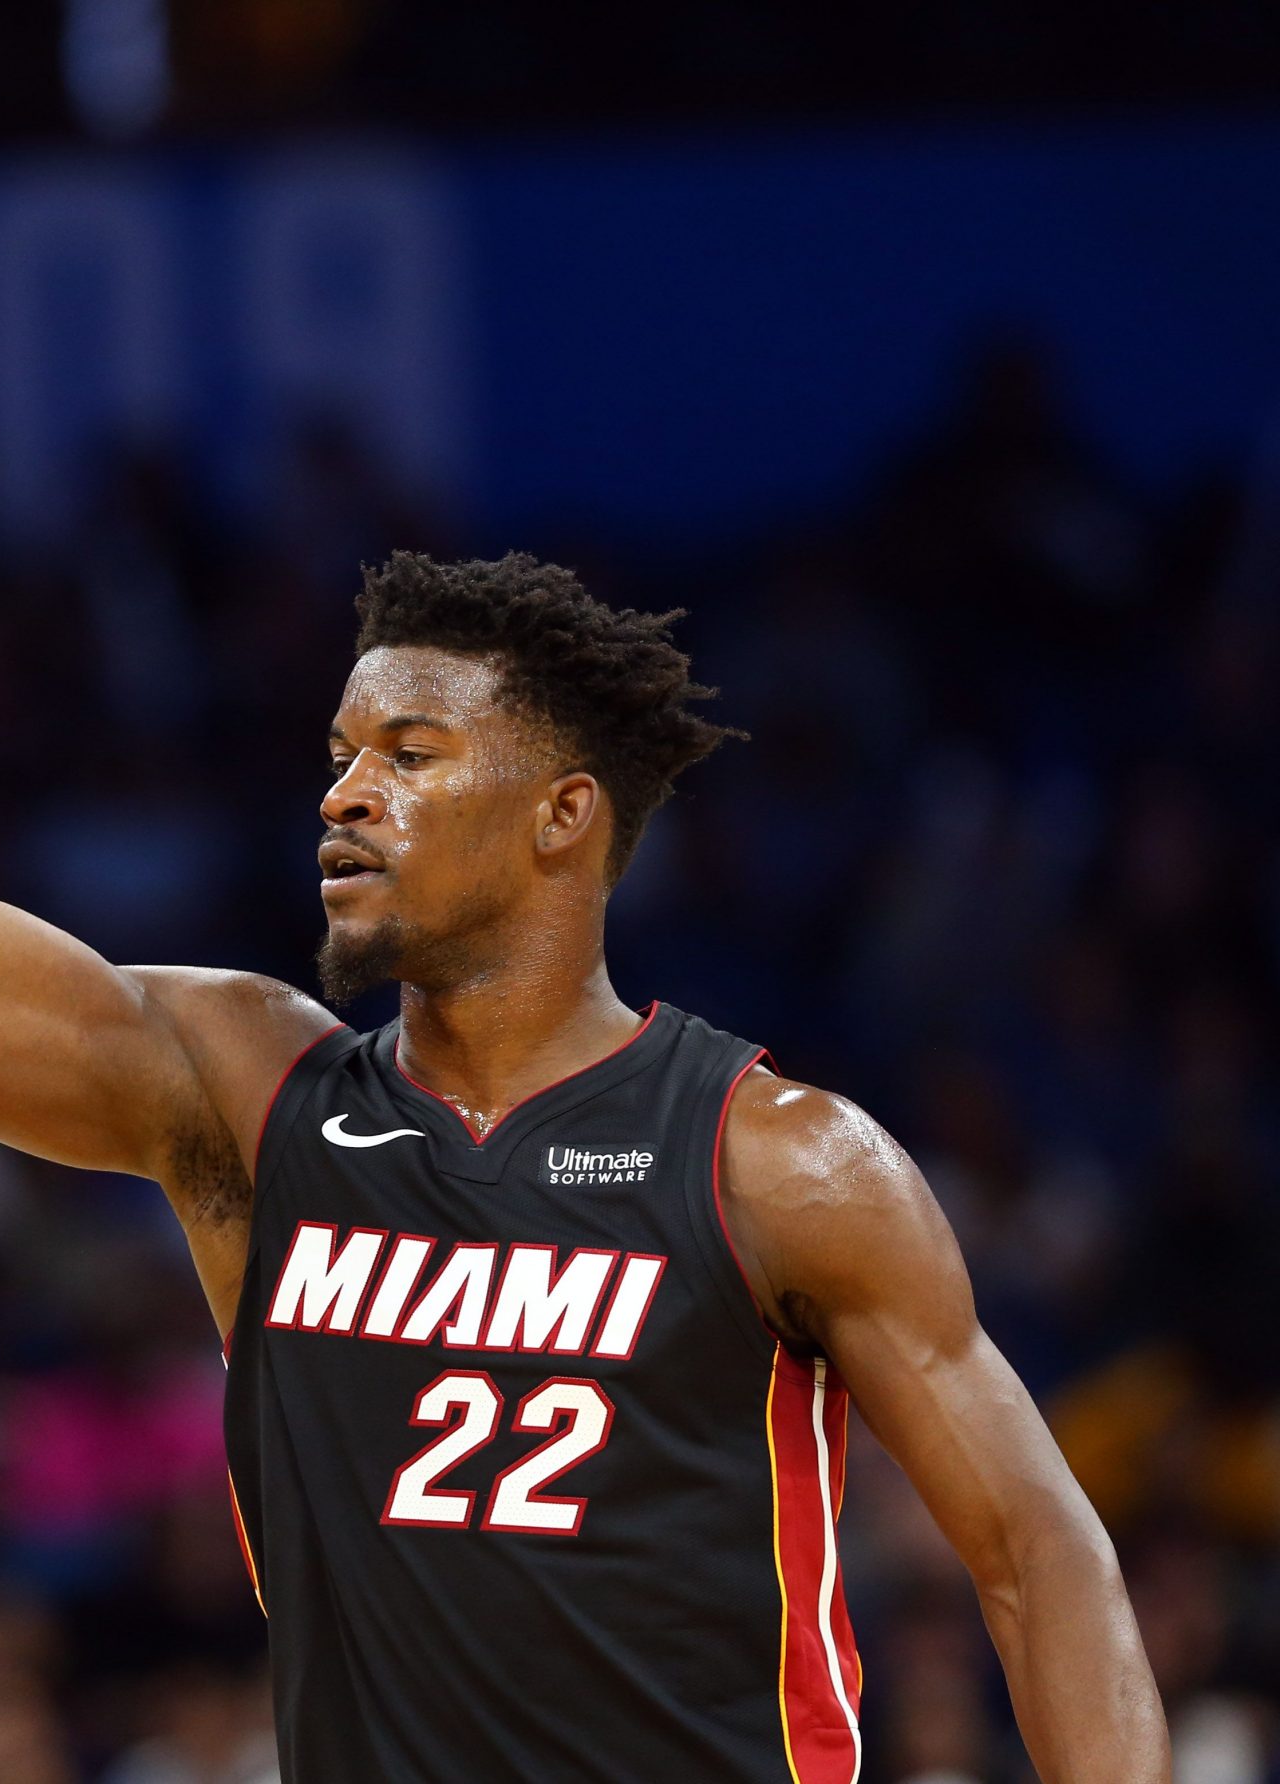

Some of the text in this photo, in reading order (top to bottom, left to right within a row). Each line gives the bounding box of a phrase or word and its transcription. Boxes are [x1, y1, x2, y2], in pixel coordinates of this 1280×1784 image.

[548, 1146, 654, 1171] Ultimate
[550, 1170, 646, 1184] SOFTWARE
[264, 1220, 668, 1360] MIAMI
[379, 1369, 616, 1536] 22
